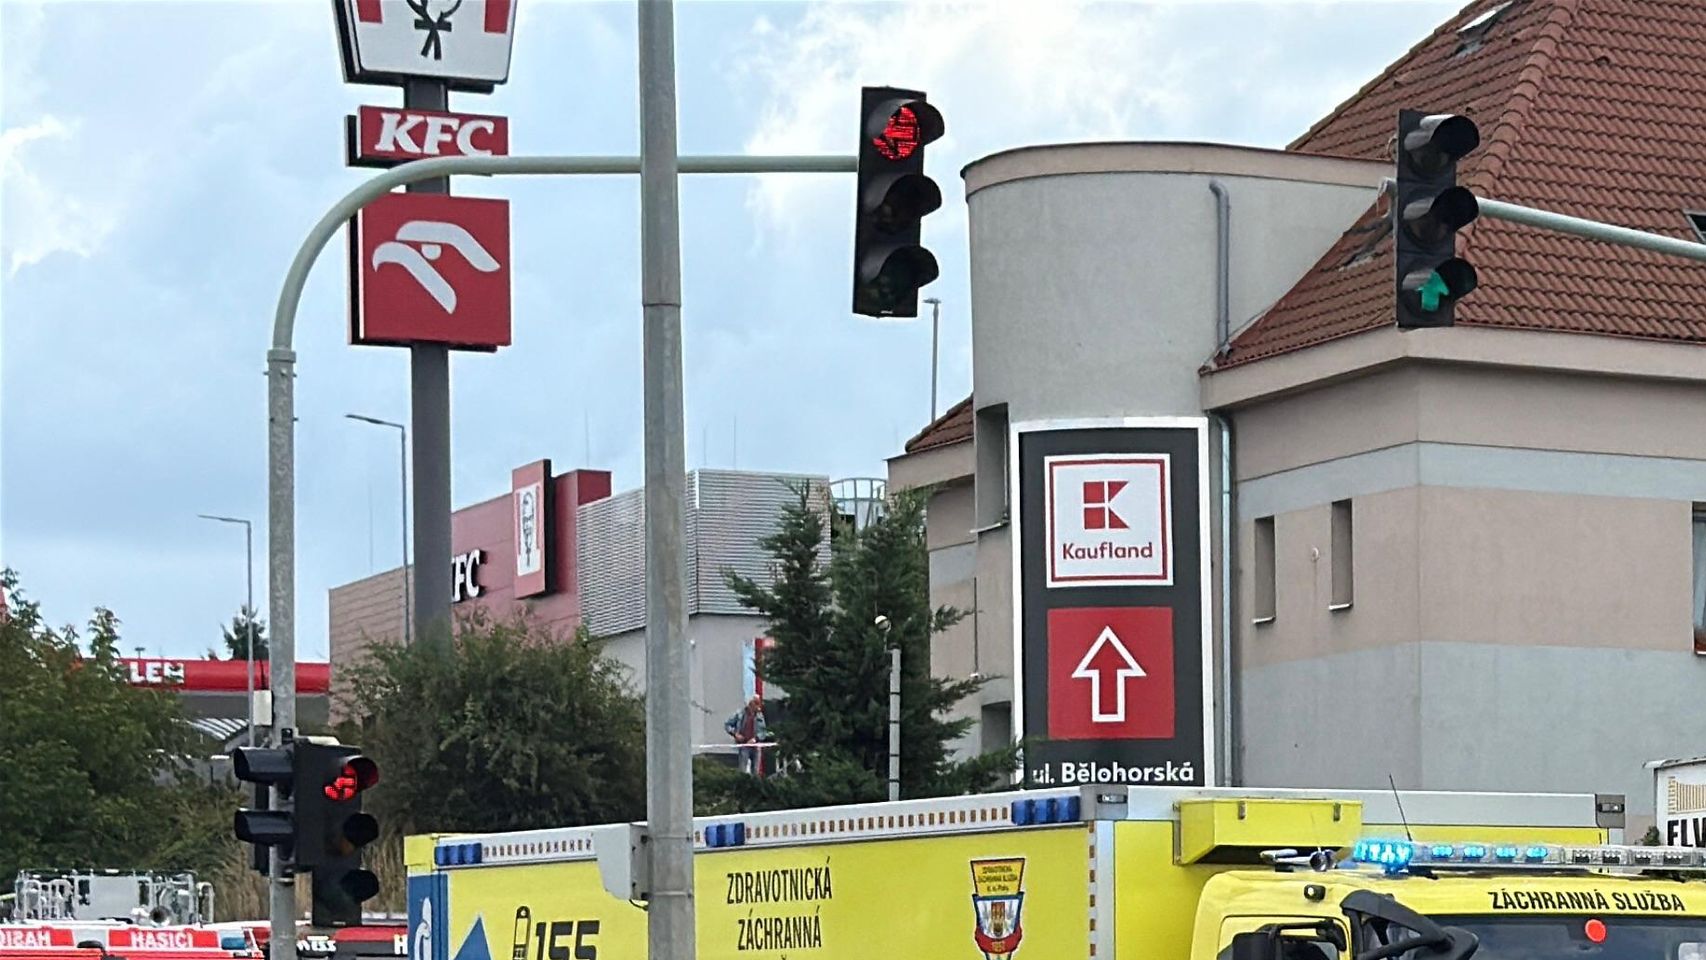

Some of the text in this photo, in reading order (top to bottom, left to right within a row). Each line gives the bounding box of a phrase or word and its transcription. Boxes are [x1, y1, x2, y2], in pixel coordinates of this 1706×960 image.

[374, 112, 495, 156] KFC
[1062, 541, 1153, 560] Kaufland
[452, 549, 482, 602] FC
[1032, 761, 1194, 784] ul. Bělohorská
[726, 856, 833, 904] ZDRAVOTNICKÁ
[1488, 888, 1686, 911] ZÁCHRANNÁ SLUŽBA
[737, 905, 823, 952] ZÁCHRANNÁ
